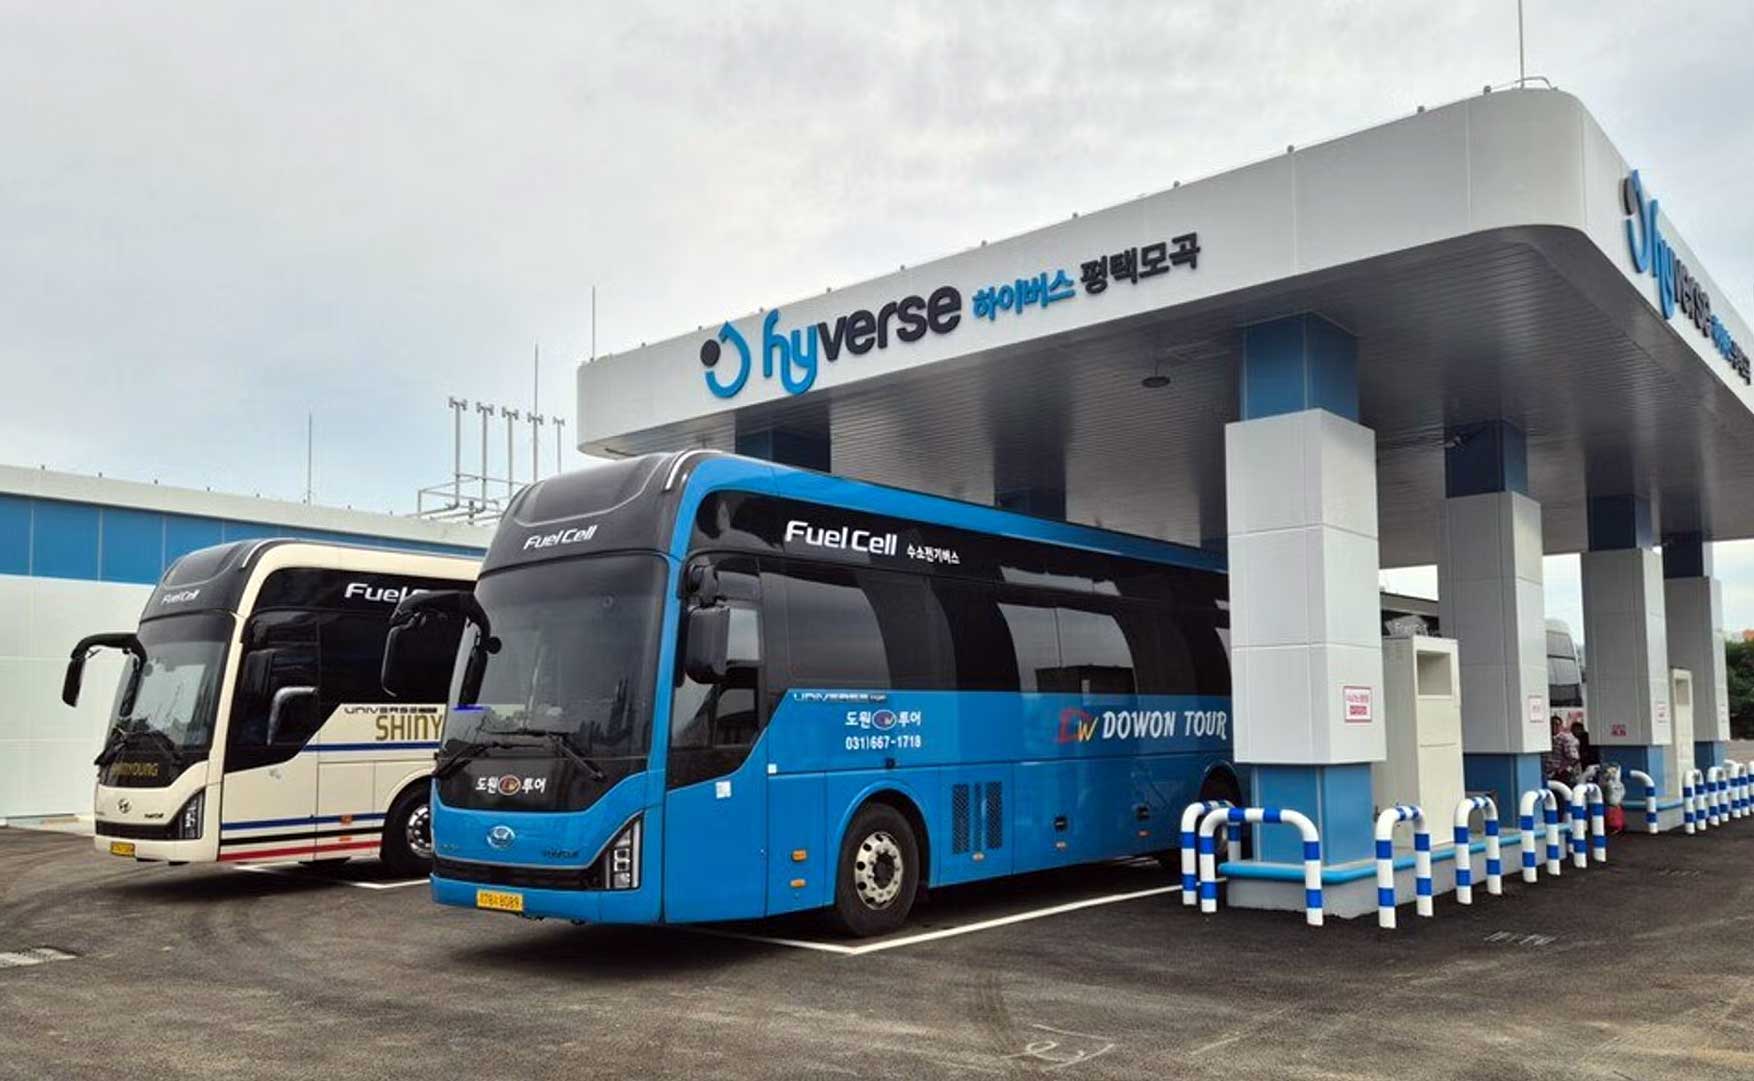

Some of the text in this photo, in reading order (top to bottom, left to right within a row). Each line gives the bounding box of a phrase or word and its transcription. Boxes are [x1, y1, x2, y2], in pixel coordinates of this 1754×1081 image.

[763, 232, 1201, 395] hyverse 하이버스 평택모곡
[523, 524, 598, 550] Fuel Cell
[784, 520, 961, 565] Fuel Cell 수소전기버스
[376, 714, 442, 741] SHINY
[845, 710, 872, 729] 도원
[898, 710, 922, 727] 투어
[1102, 710, 1176, 740] DOWON
[1184, 710, 1227, 740] TOUR
[475, 776, 499, 794] 도원
[521, 777, 547, 794] 투어
